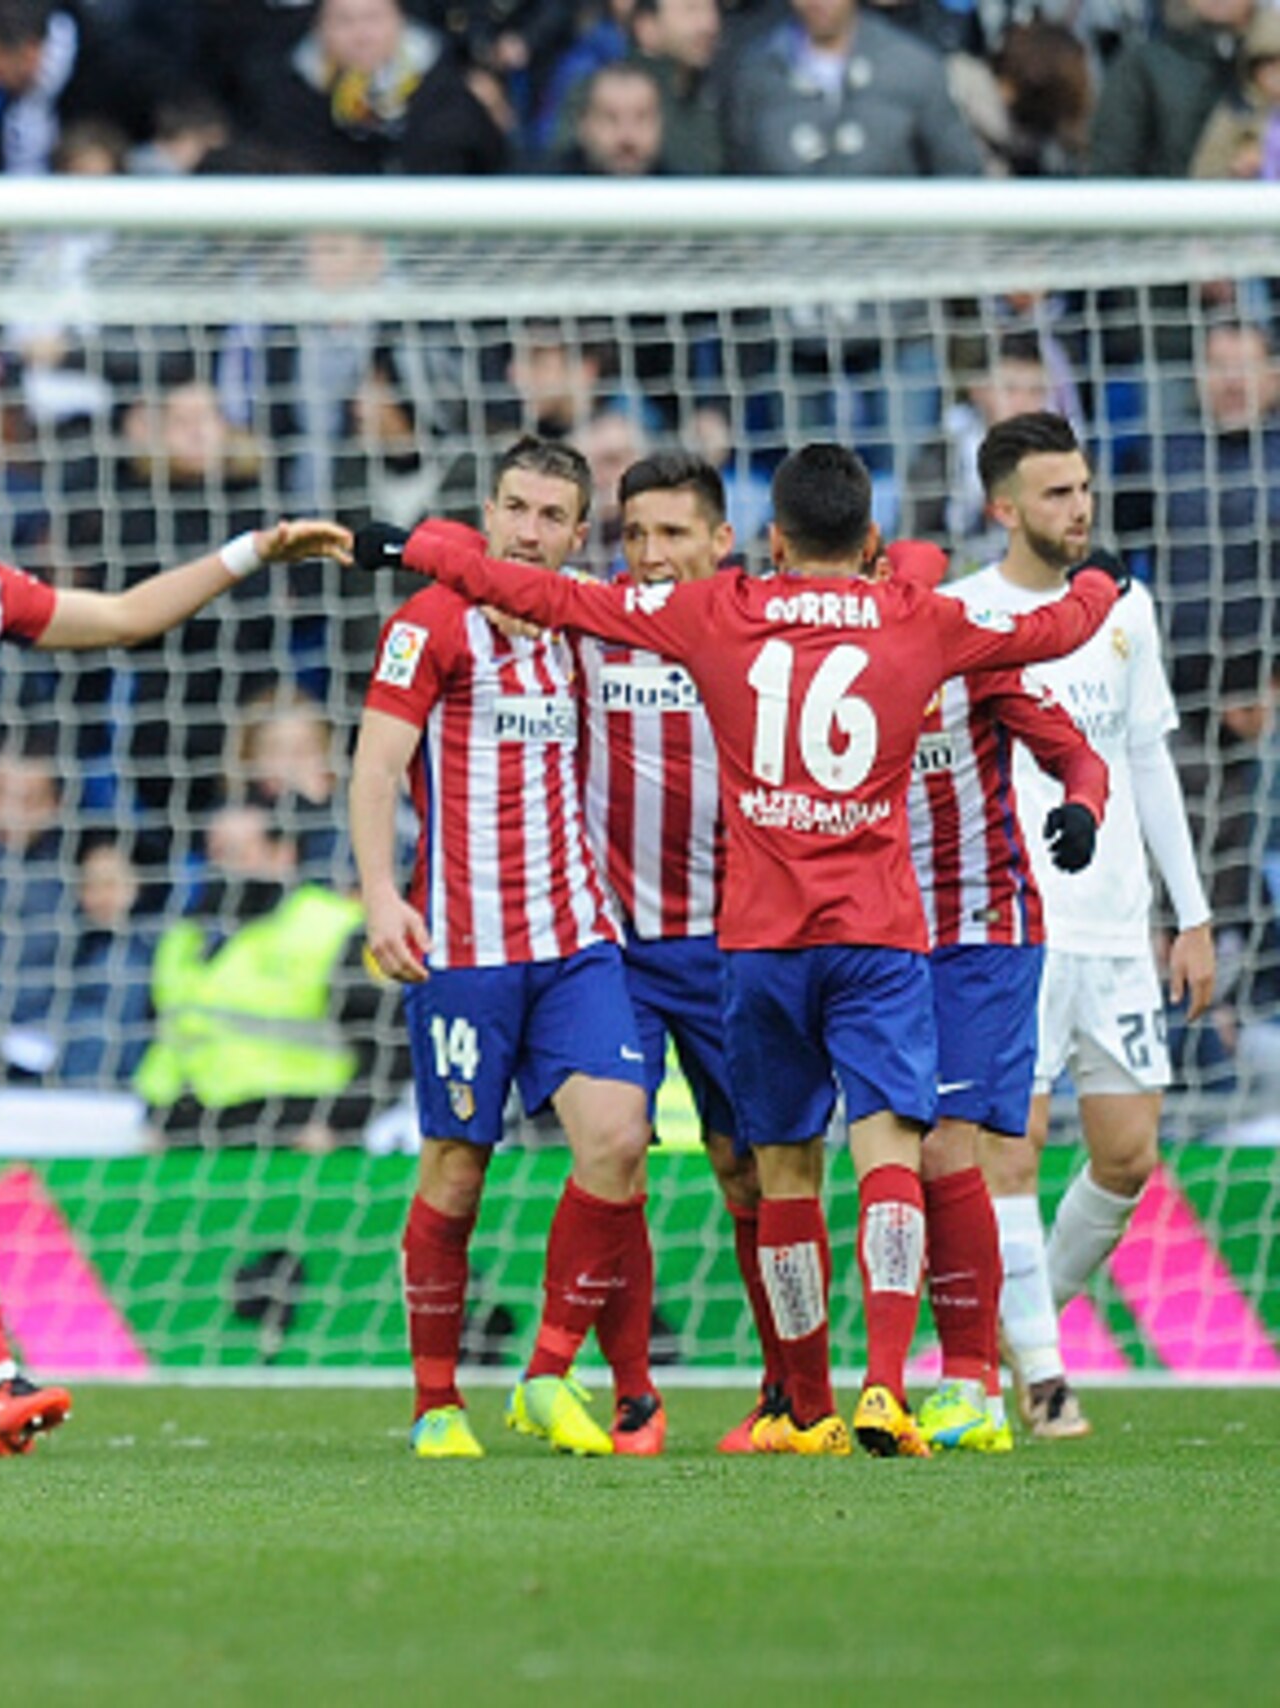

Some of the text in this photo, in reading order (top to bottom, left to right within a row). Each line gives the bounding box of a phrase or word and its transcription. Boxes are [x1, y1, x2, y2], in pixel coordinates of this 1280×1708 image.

[764, 592, 880, 629] CORREA
[747, 637, 879, 793] 16
[430, 1015, 480, 1081] 14
